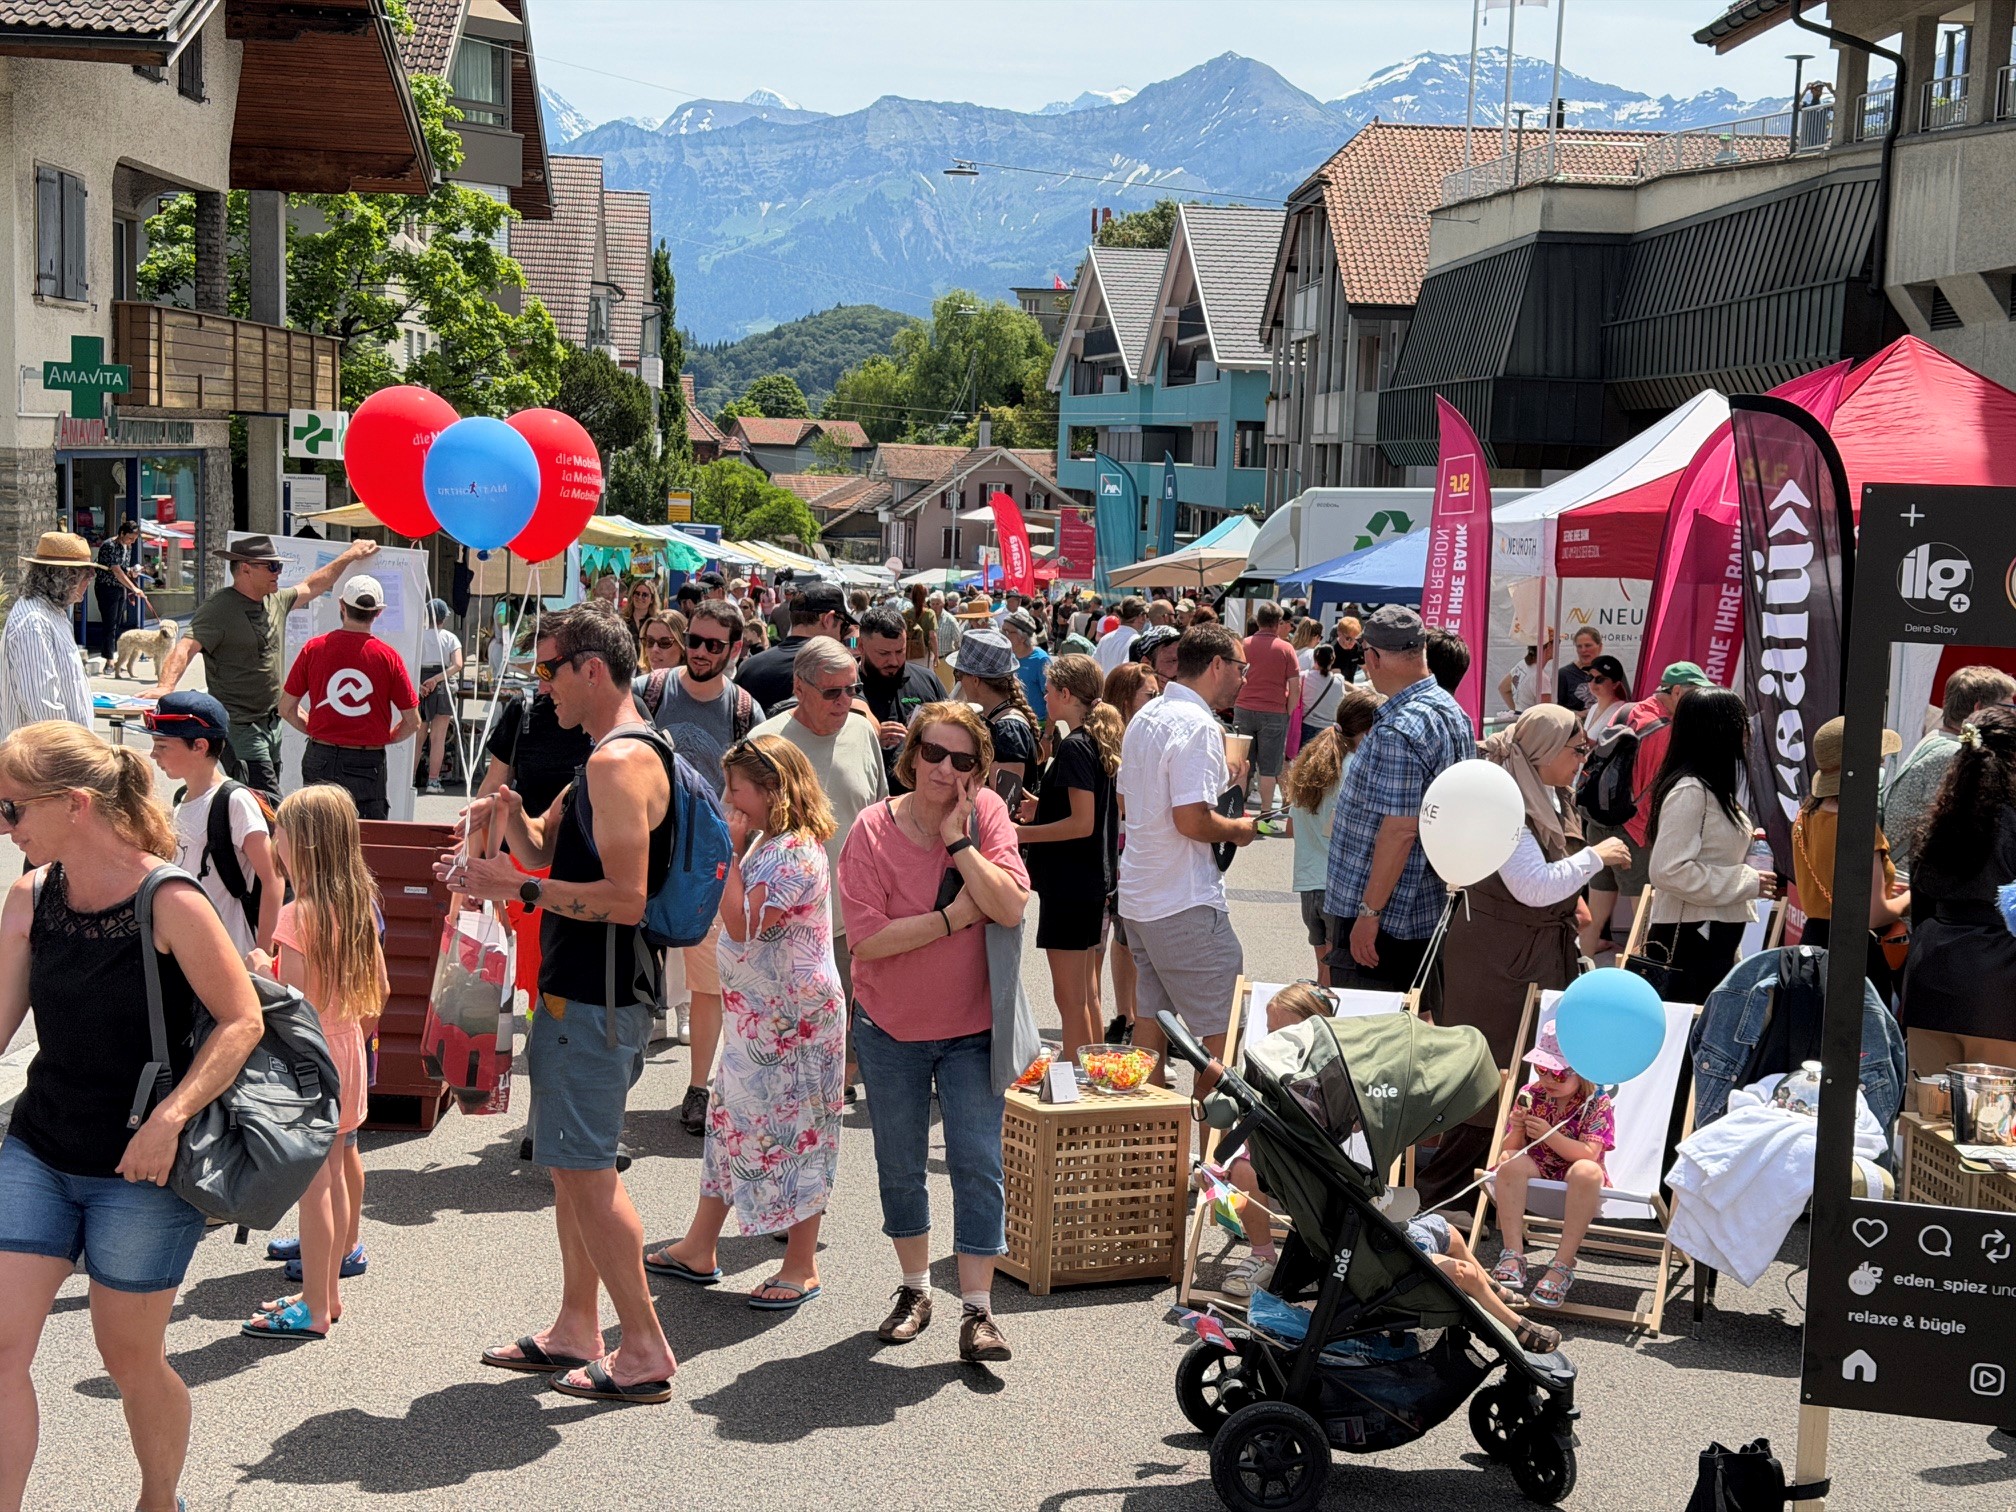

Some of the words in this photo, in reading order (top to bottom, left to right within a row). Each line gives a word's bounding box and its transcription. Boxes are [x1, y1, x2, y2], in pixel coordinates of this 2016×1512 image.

[48, 366, 124, 386] AMAVITA
[556, 453, 572, 466] die
[1901, 543, 1971, 601] ilg
[1599, 608, 1644, 625] NEU
[1714, 584, 1743, 633] IHRE
[1904, 623, 1931, 633] Deine
[1933, 624, 1958, 635] Story
[1365, 1083, 1398, 1098] Joie
[1333, 1249, 1352, 1282] Joie
[1893, 1273, 1988, 1294] eden_spiez
[1848, 1311, 1899, 1326] relaxe
[1902, 1315, 1915, 1329] &
[1919, 1316, 1966, 1335] bügle
